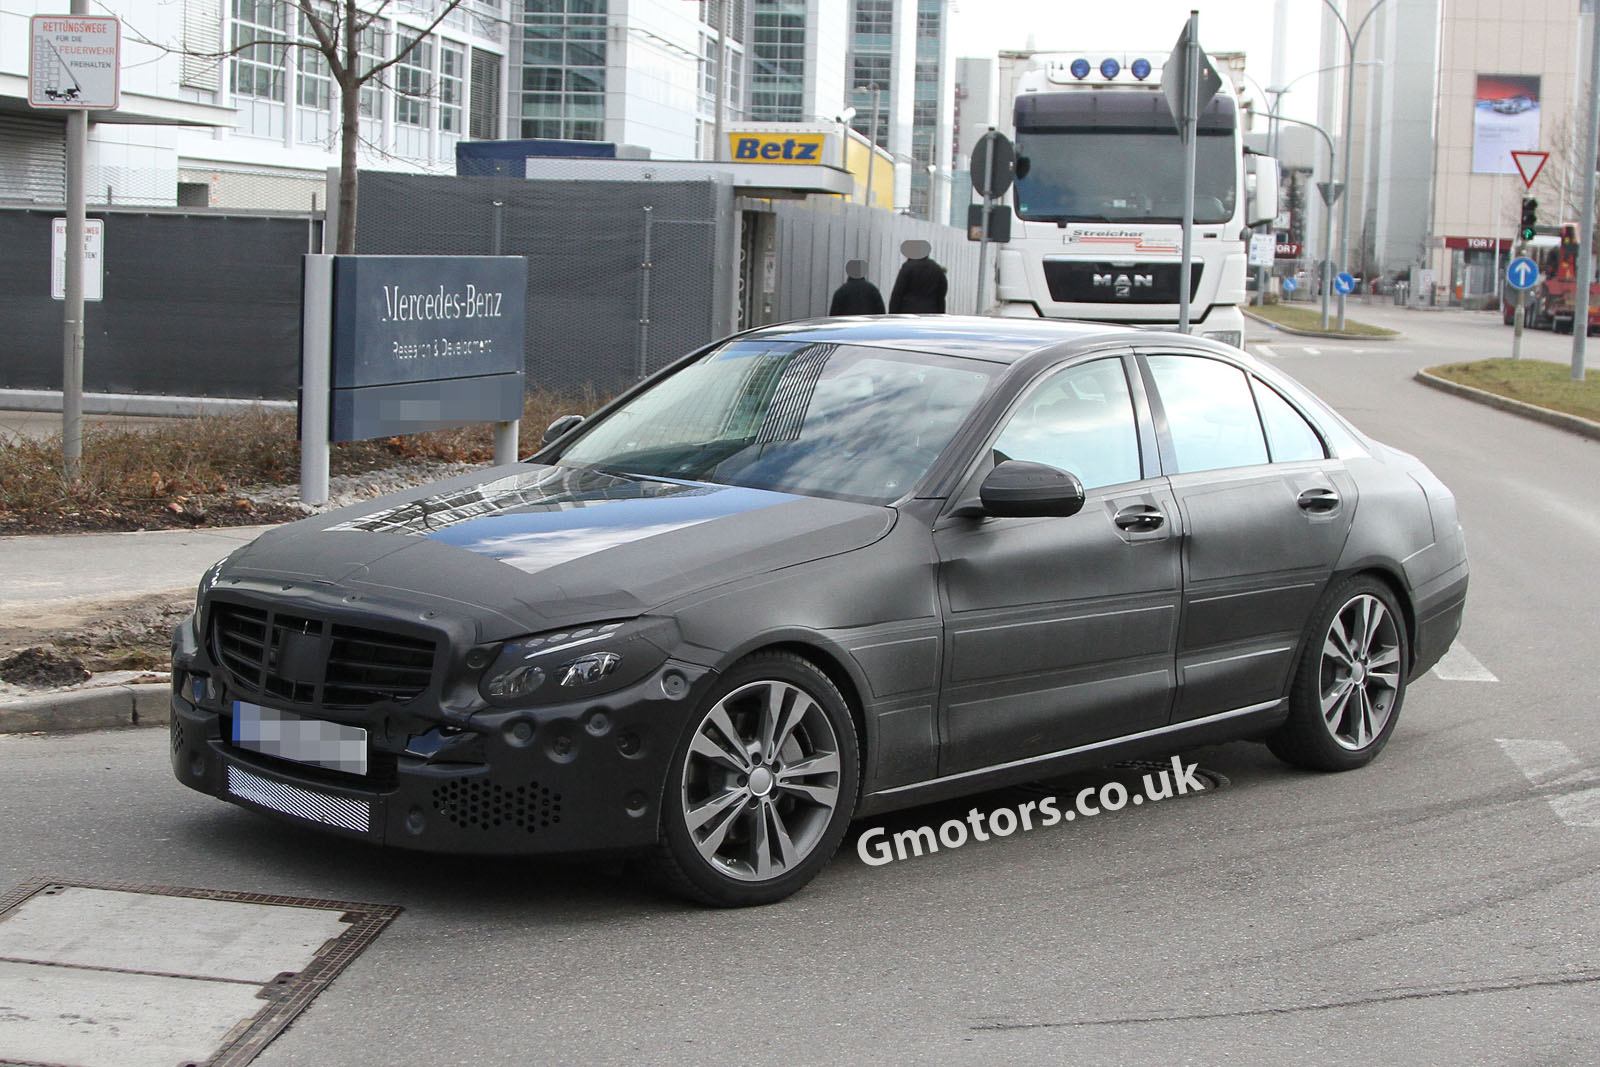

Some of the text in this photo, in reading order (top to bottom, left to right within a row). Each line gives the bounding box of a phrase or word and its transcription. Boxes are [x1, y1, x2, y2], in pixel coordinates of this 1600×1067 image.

[42, 22, 108, 33] RETTUNGSWEGE
[60, 46, 115, 55] FEUERWEHR
[735, 138, 819, 160] Betz
[1073, 229, 1144, 237] Streicher
[1467, 238, 1494, 248] TOR 7
[1275, 244, 1298, 254] OR 7
[1093, 273, 1153, 287] MAN
[382, 284, 503, 321] Mercedes-Benz
[393, 341, 431, 360] Reseach
